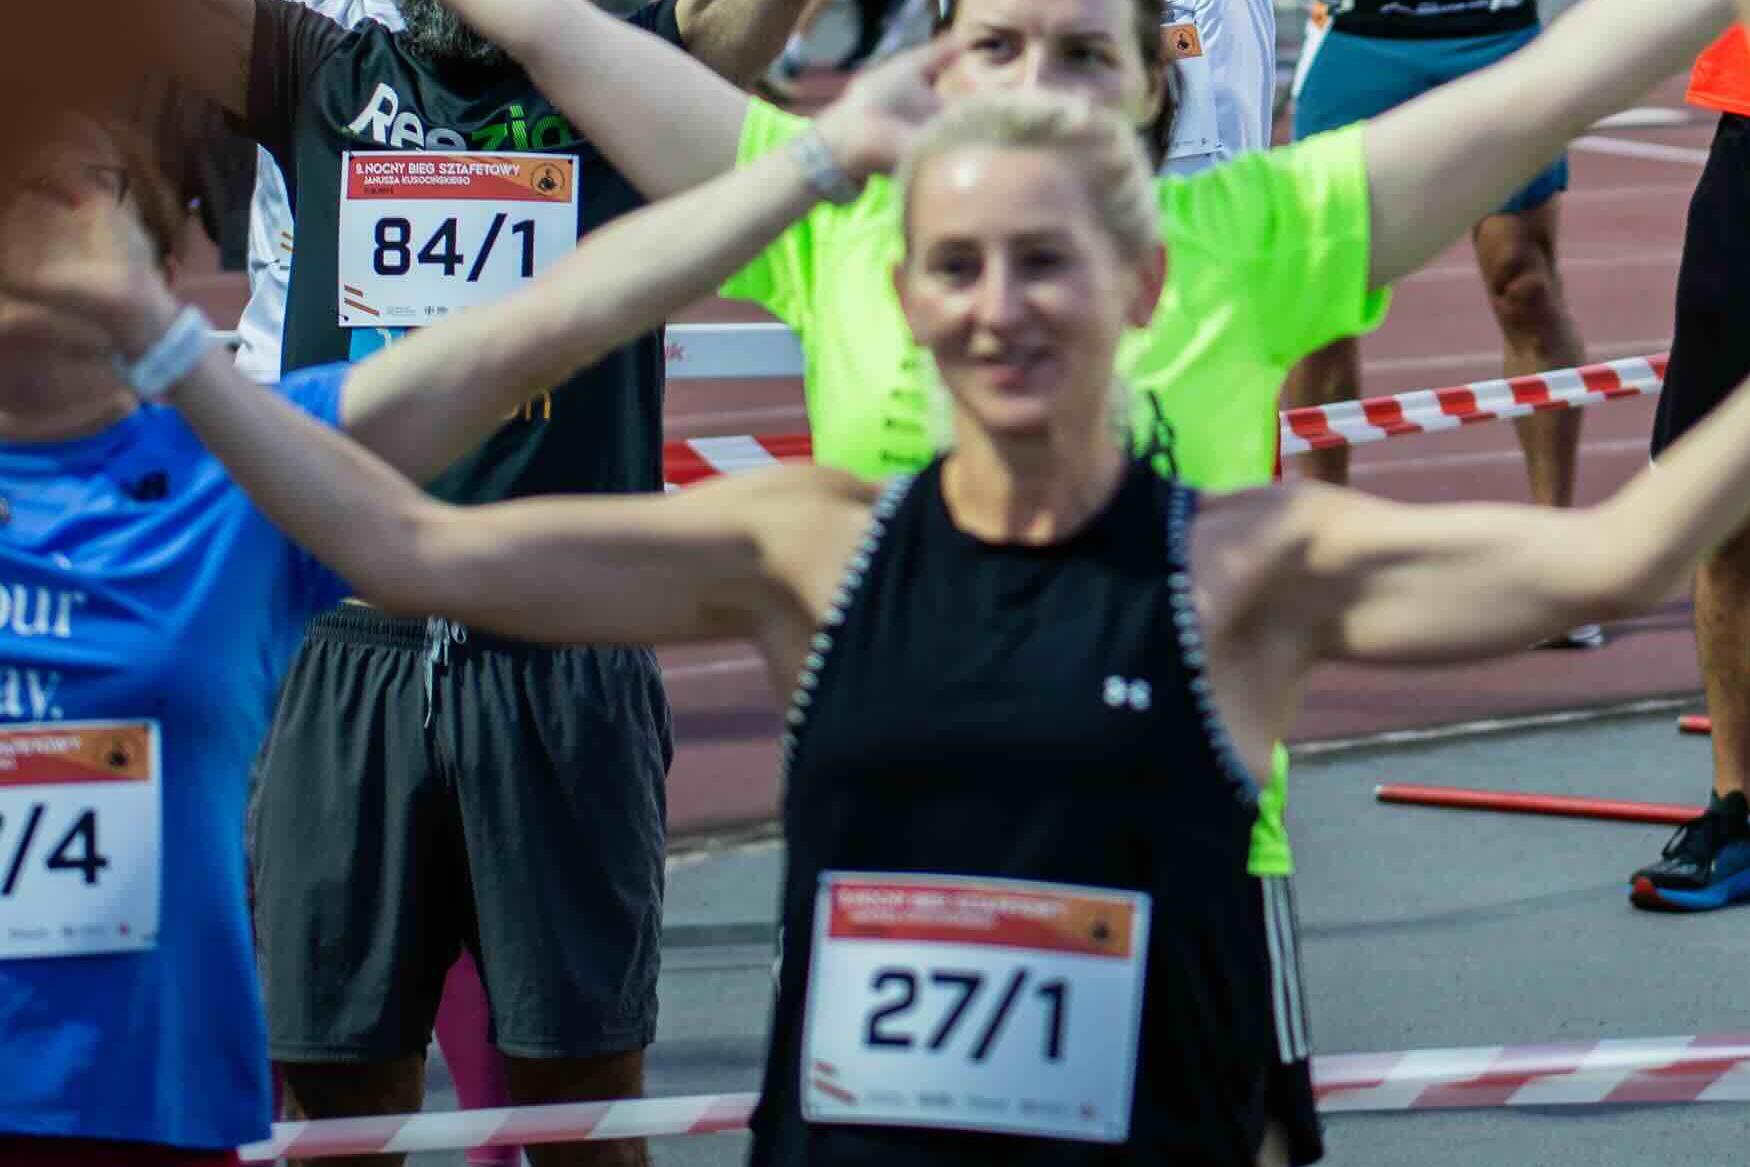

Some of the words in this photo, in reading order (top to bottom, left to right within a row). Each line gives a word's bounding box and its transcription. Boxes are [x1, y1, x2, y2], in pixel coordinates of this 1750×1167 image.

[408, 162, 435, 175] BIEG
[373, 212, 536, 282] 84/1
[0, 802, 109, 897] /4
[861, 963, 1073, 1065] 27/1
